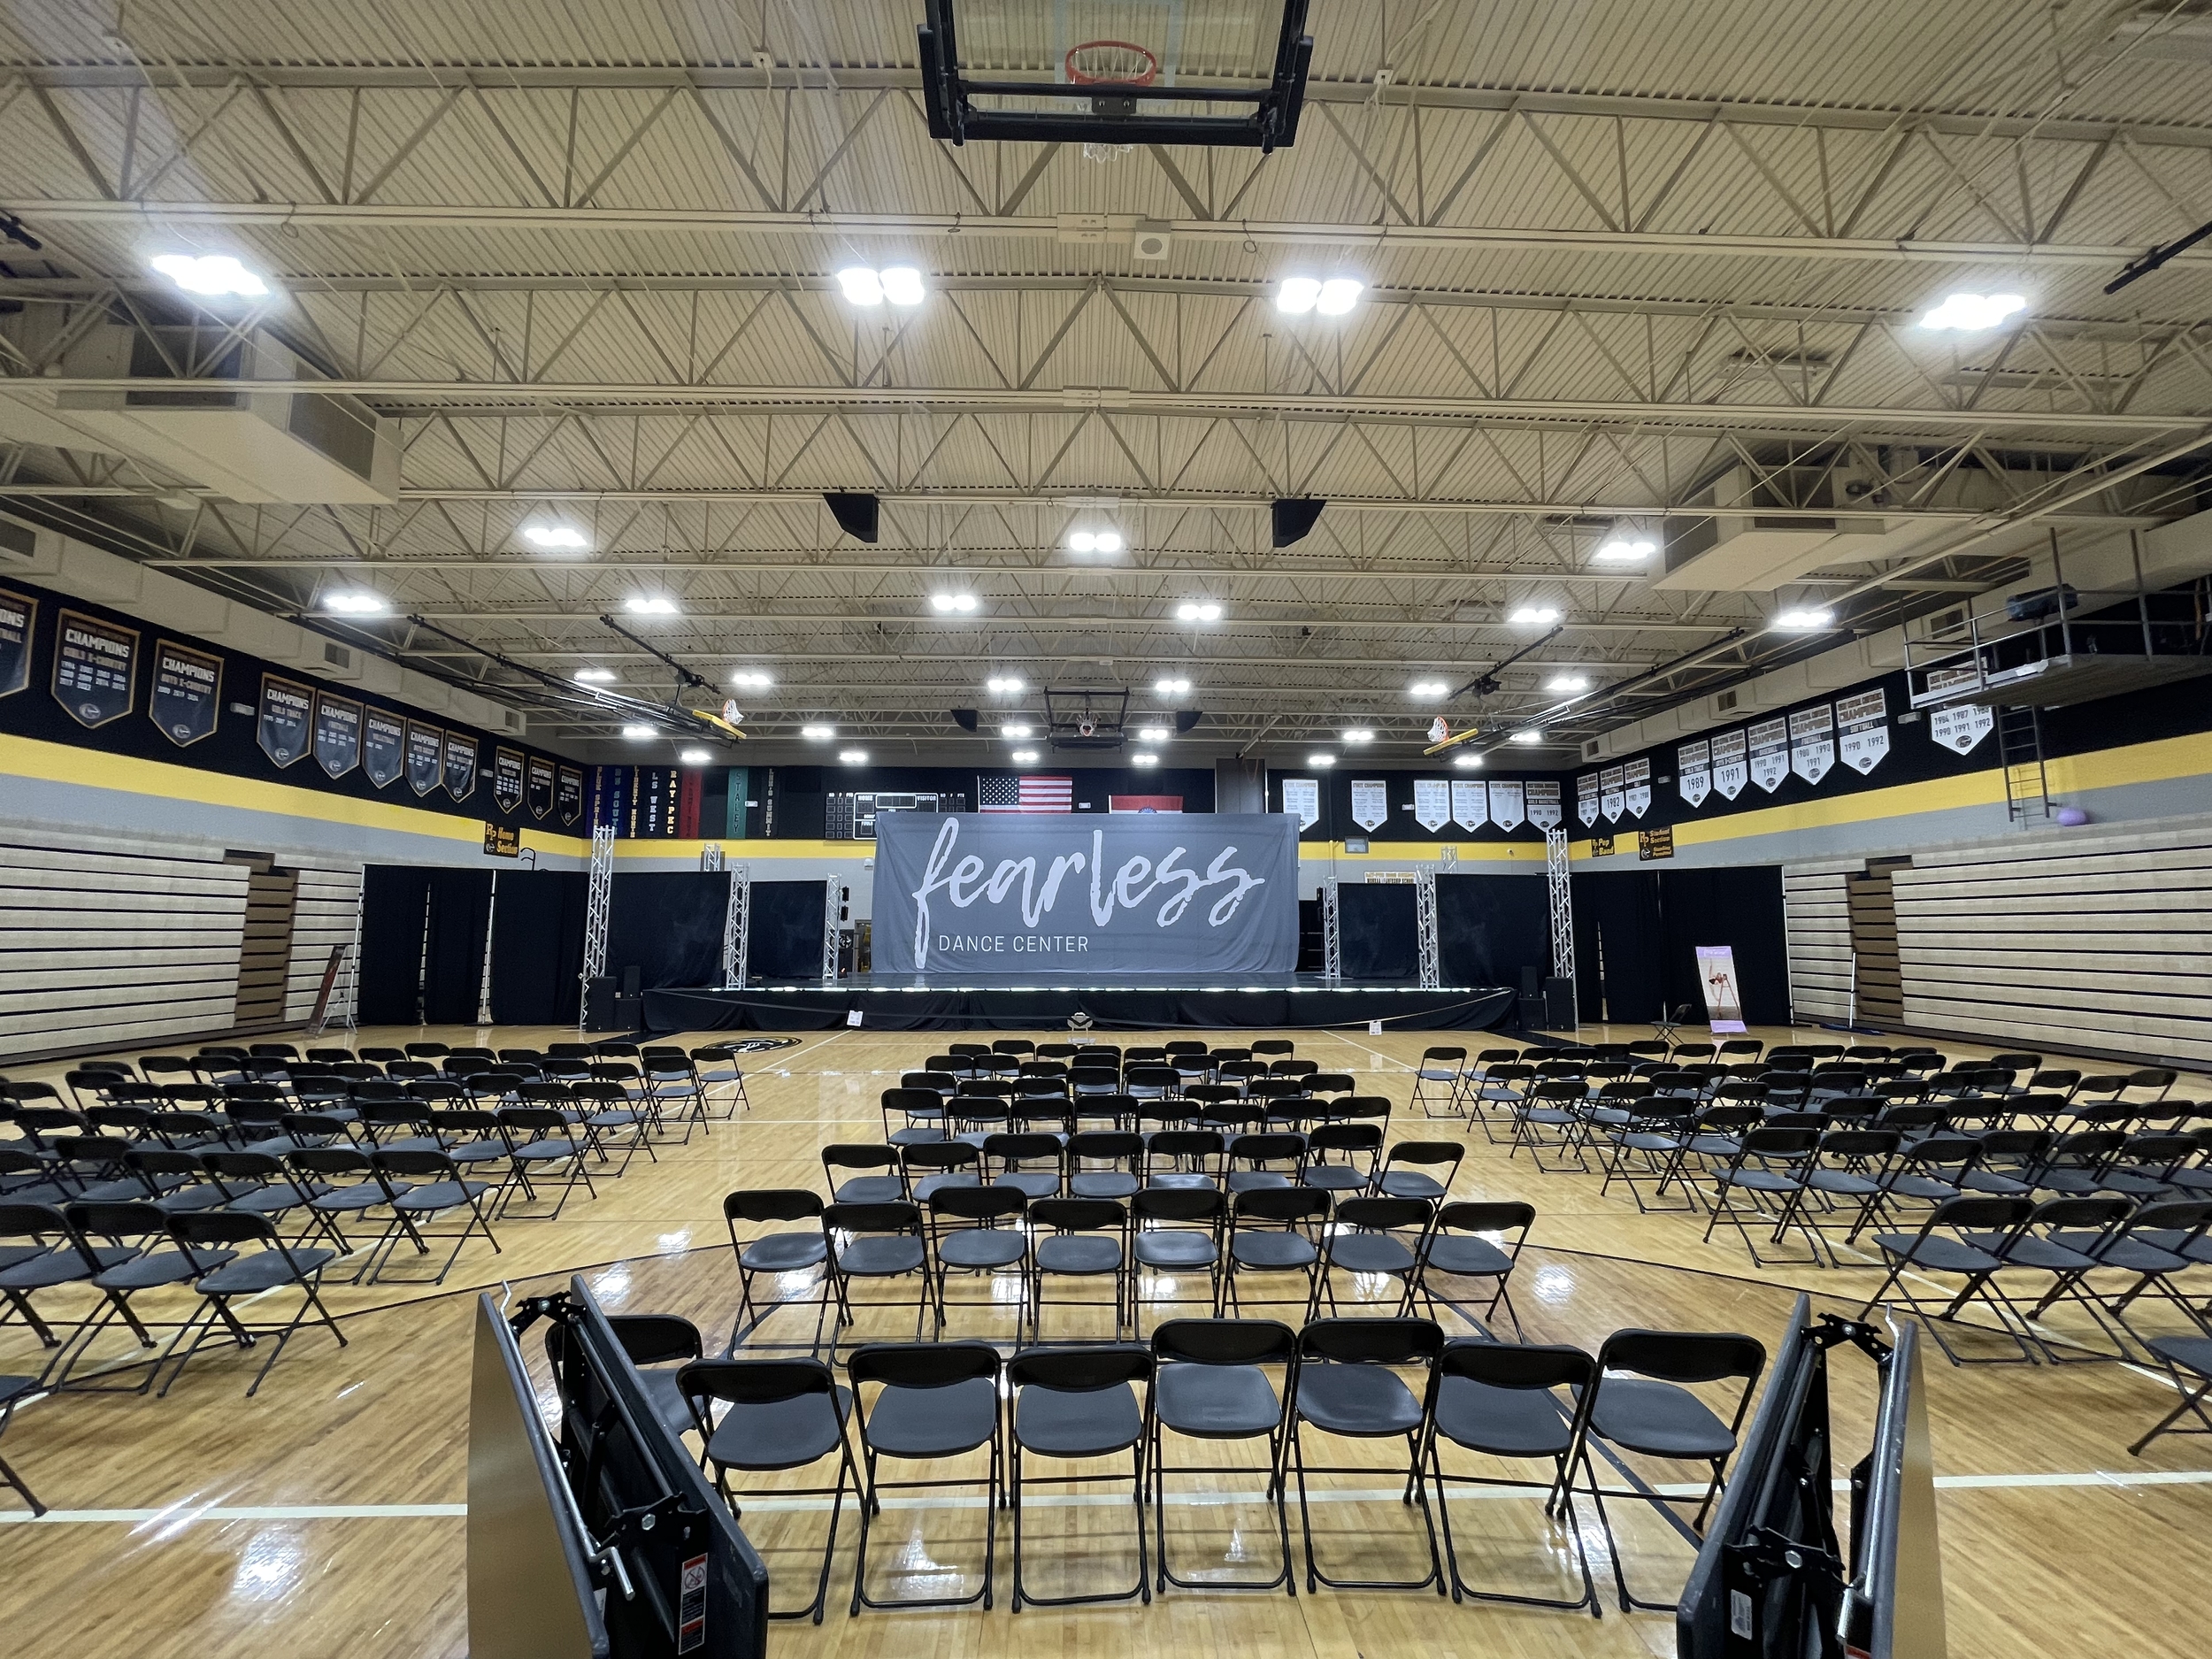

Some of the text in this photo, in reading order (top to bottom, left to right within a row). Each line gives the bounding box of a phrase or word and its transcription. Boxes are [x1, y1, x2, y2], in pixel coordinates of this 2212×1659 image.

[65, 628, 130, 658] CHAMPIONS
[162, 657, 215, 682] CHAMPIONS
[267, 689, 309, 709] CHAMPIONS
[321, 705, 358, 724] CHAMPIONS
[1839, 701, 1884, 723] CHAMPIONS
[1952, 710, 1968, 720] 1987
[369, 719, 401, 737] CHAMPIONS
[1791, 716, 1831, 735] CHAMPIONS
[1935, 718, 1990, 737] 1990 1991 1992
[411, 731, 439, 747] CHAMPIONS
[1750, 729, 1784, 746] CHAMPIONS
[1844, 736, 1884, 752] 1990 1992
[448, 742, 474, 757] CHAMPIONS
[1713, 741, 1745, 756] CHAMPIONS
[1816, 744, 1830, 754] 1990
[499, 757, 521, 770] CHAMPIONS
[1680, 750, 1708, 766] CHAMPIONS
[1754, 755, 1785, 768] 1990 1991
[1807, 757, 1820, 767] 1991
[1721, 767, 1739, 783] 1991
[1763, 767, 1777, 777] 1992
[1687, 776, 1704, 790] 1989
[649, 772, 658, 831] LS WEST
[733, 772, 741, 832] STALEY
[1606, 797, 1620, 808] 1982
[1599, 846, 1613, 855] Band
[912, 817, 1265, 969] fearless
[939, 935, 1088, 952] DANCE CENTER
